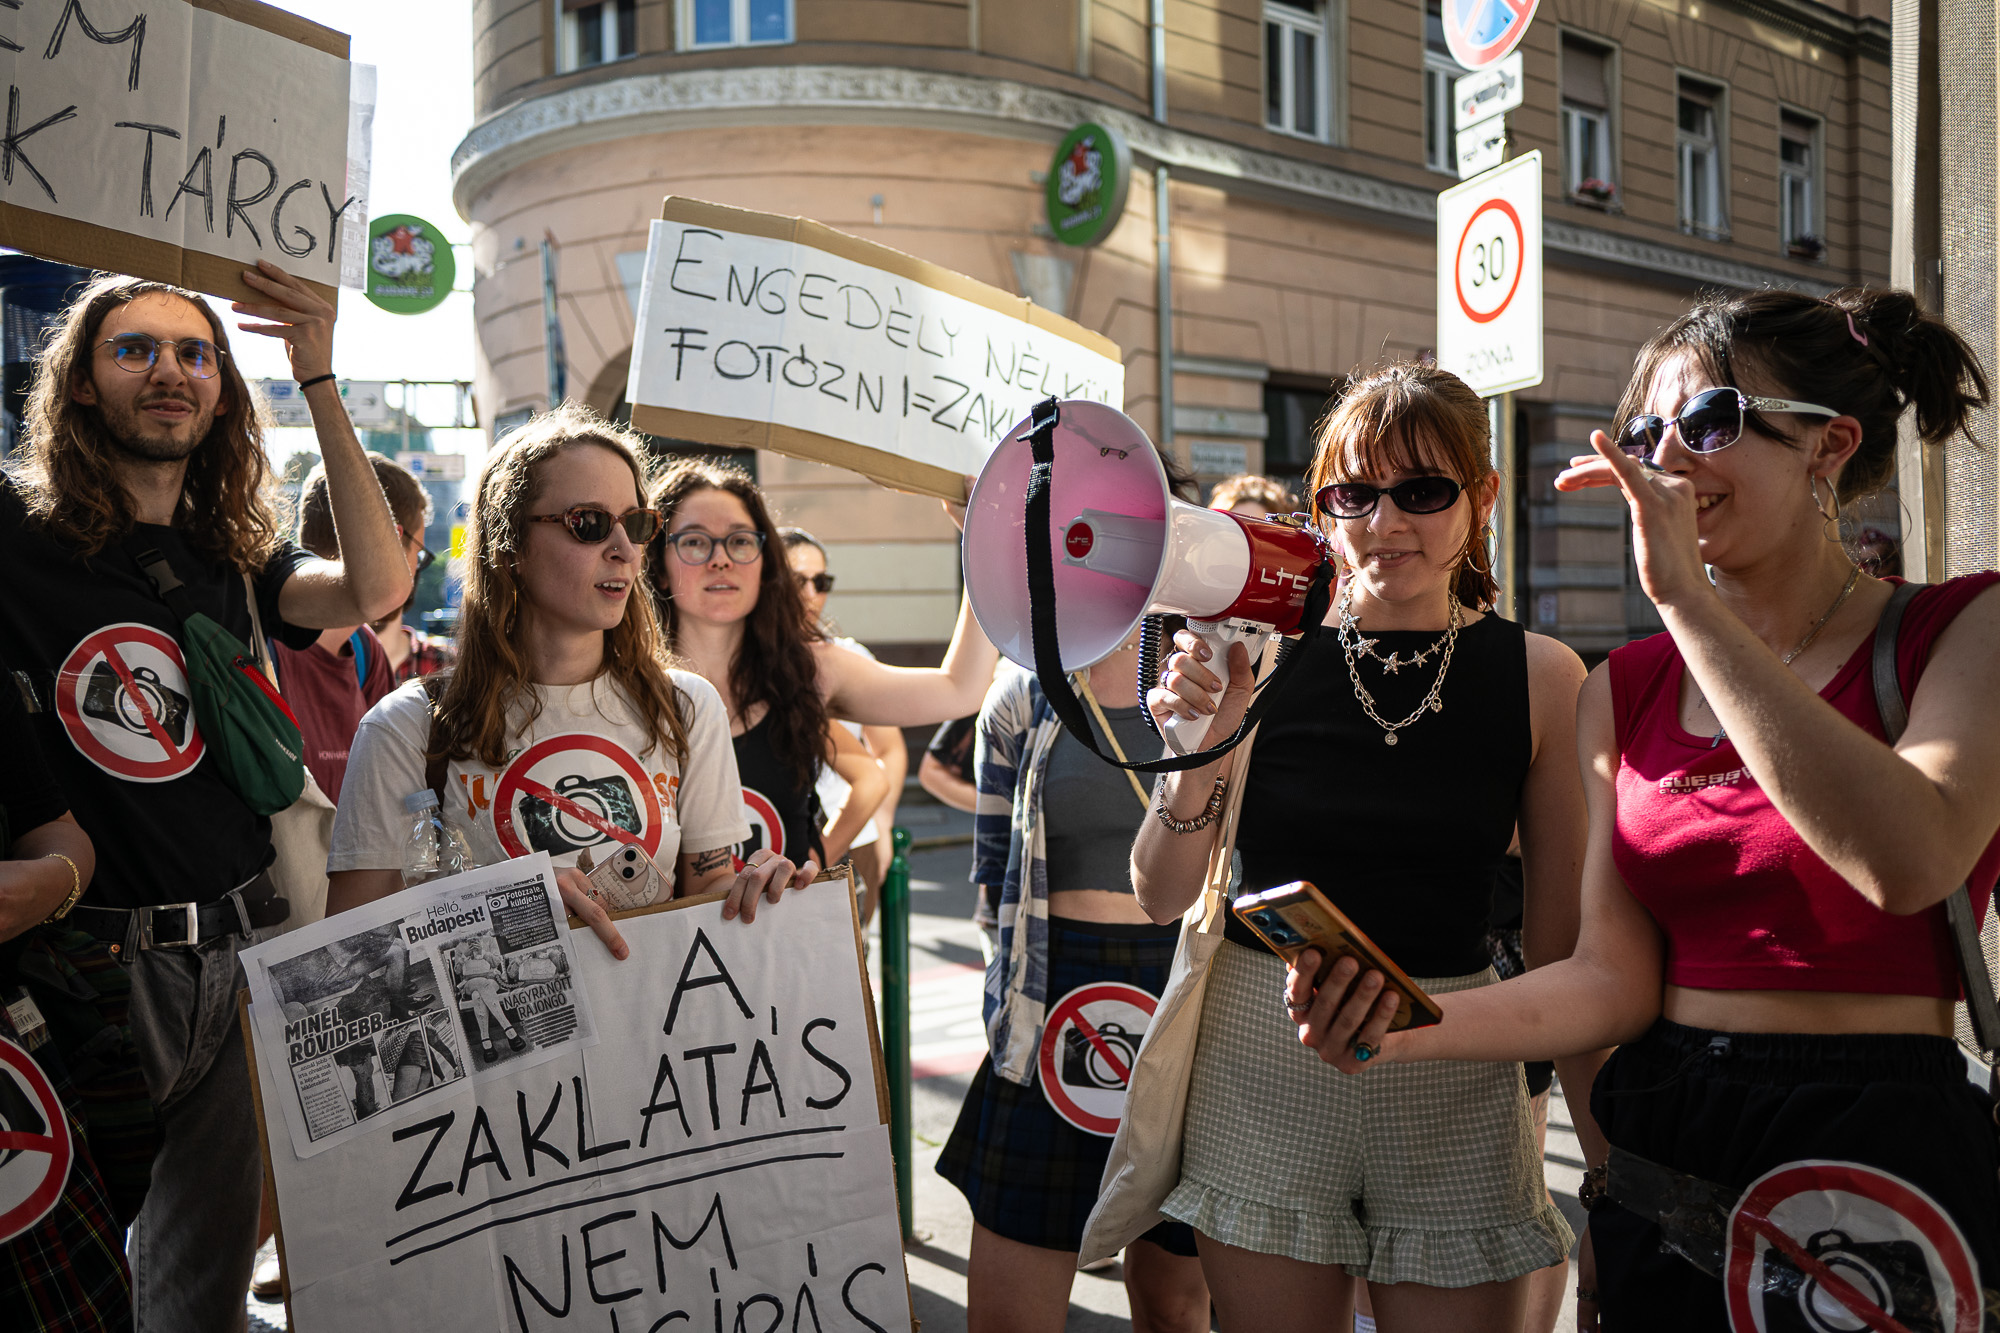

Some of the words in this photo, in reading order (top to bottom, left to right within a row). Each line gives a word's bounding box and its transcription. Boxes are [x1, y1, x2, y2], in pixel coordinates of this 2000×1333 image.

[114, 114, 357, 264] TÁRGY
[1472, 236, 1505, 287] 30
[1260, 567, 1309, 591] LTC
[1660, 769, 1741, 788] GUESS
[426, 901, 462, 919] Helló,
[506, 887, 533, 901] Fotózza
[510, 895, 533, 908] küldje
[533, 893, 545, 902] be!
[406, 905, 486, 945] Budapest!
[503, 985, 546, 1010] NAGYRA
[663, 927, 755, 1035] A
[518, 992, 567, 1020] RAJONGÓ
[285, 1007, 341, 1044] MINÉL
[290, 1011, 399, 1063] RÖVIDEBB...
[392, 1005, 852, 1211] ZAKLATÁS
[503, 1192, 738, 1333] NEM
